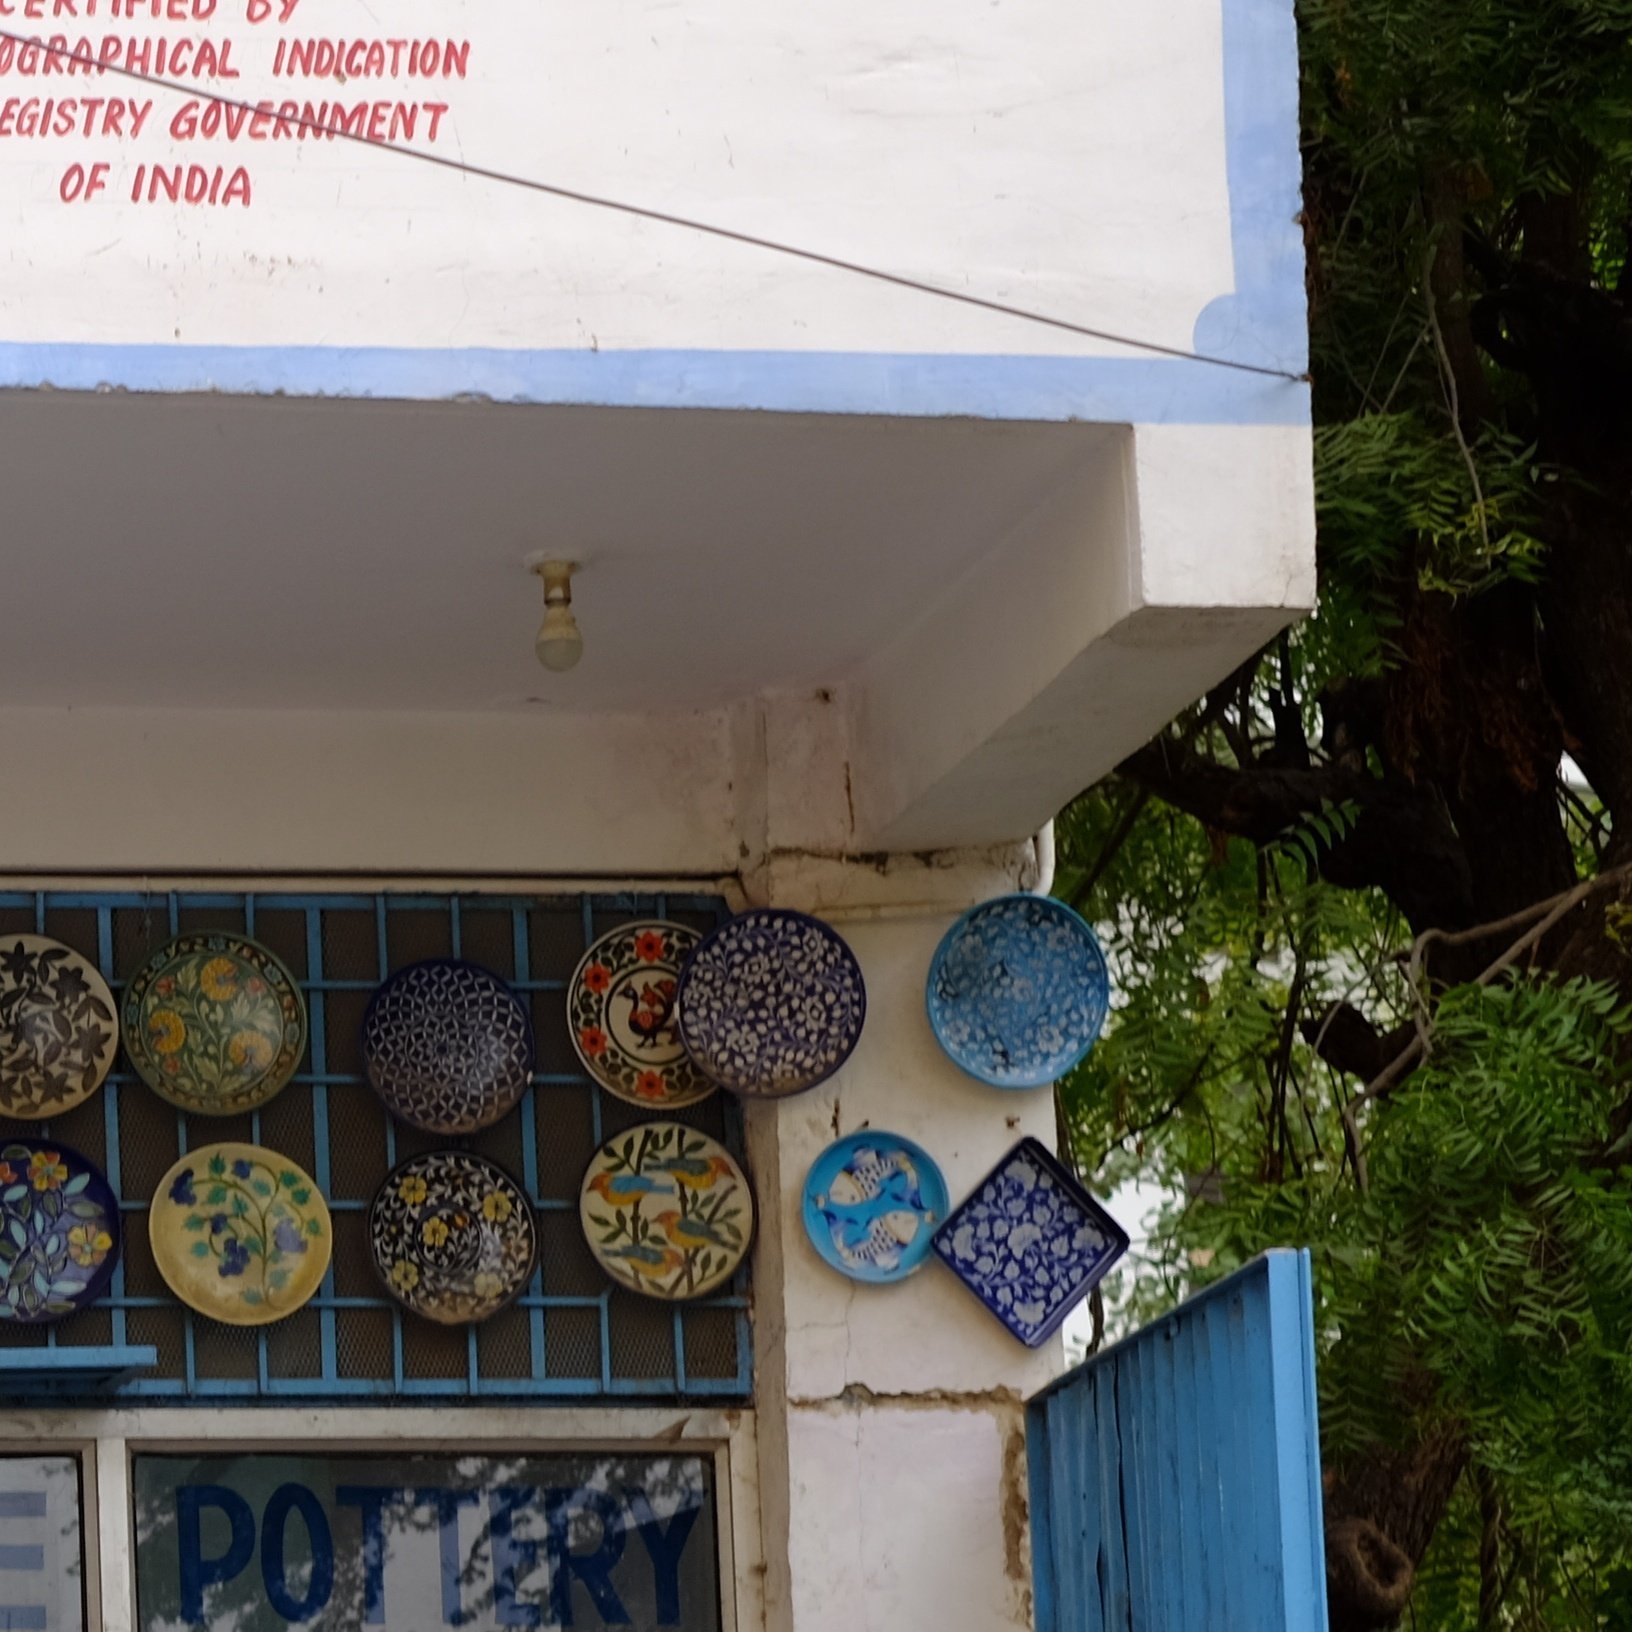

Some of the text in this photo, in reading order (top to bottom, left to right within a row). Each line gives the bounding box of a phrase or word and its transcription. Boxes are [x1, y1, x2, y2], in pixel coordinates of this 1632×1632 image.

[272, 38, 471, 79] INDICATION
[169, 100, 448, 142] GOVERNMENT
[59, 163, 251, 207] OF INDIA
[173, 1483, 705, 1628] POTTERY
